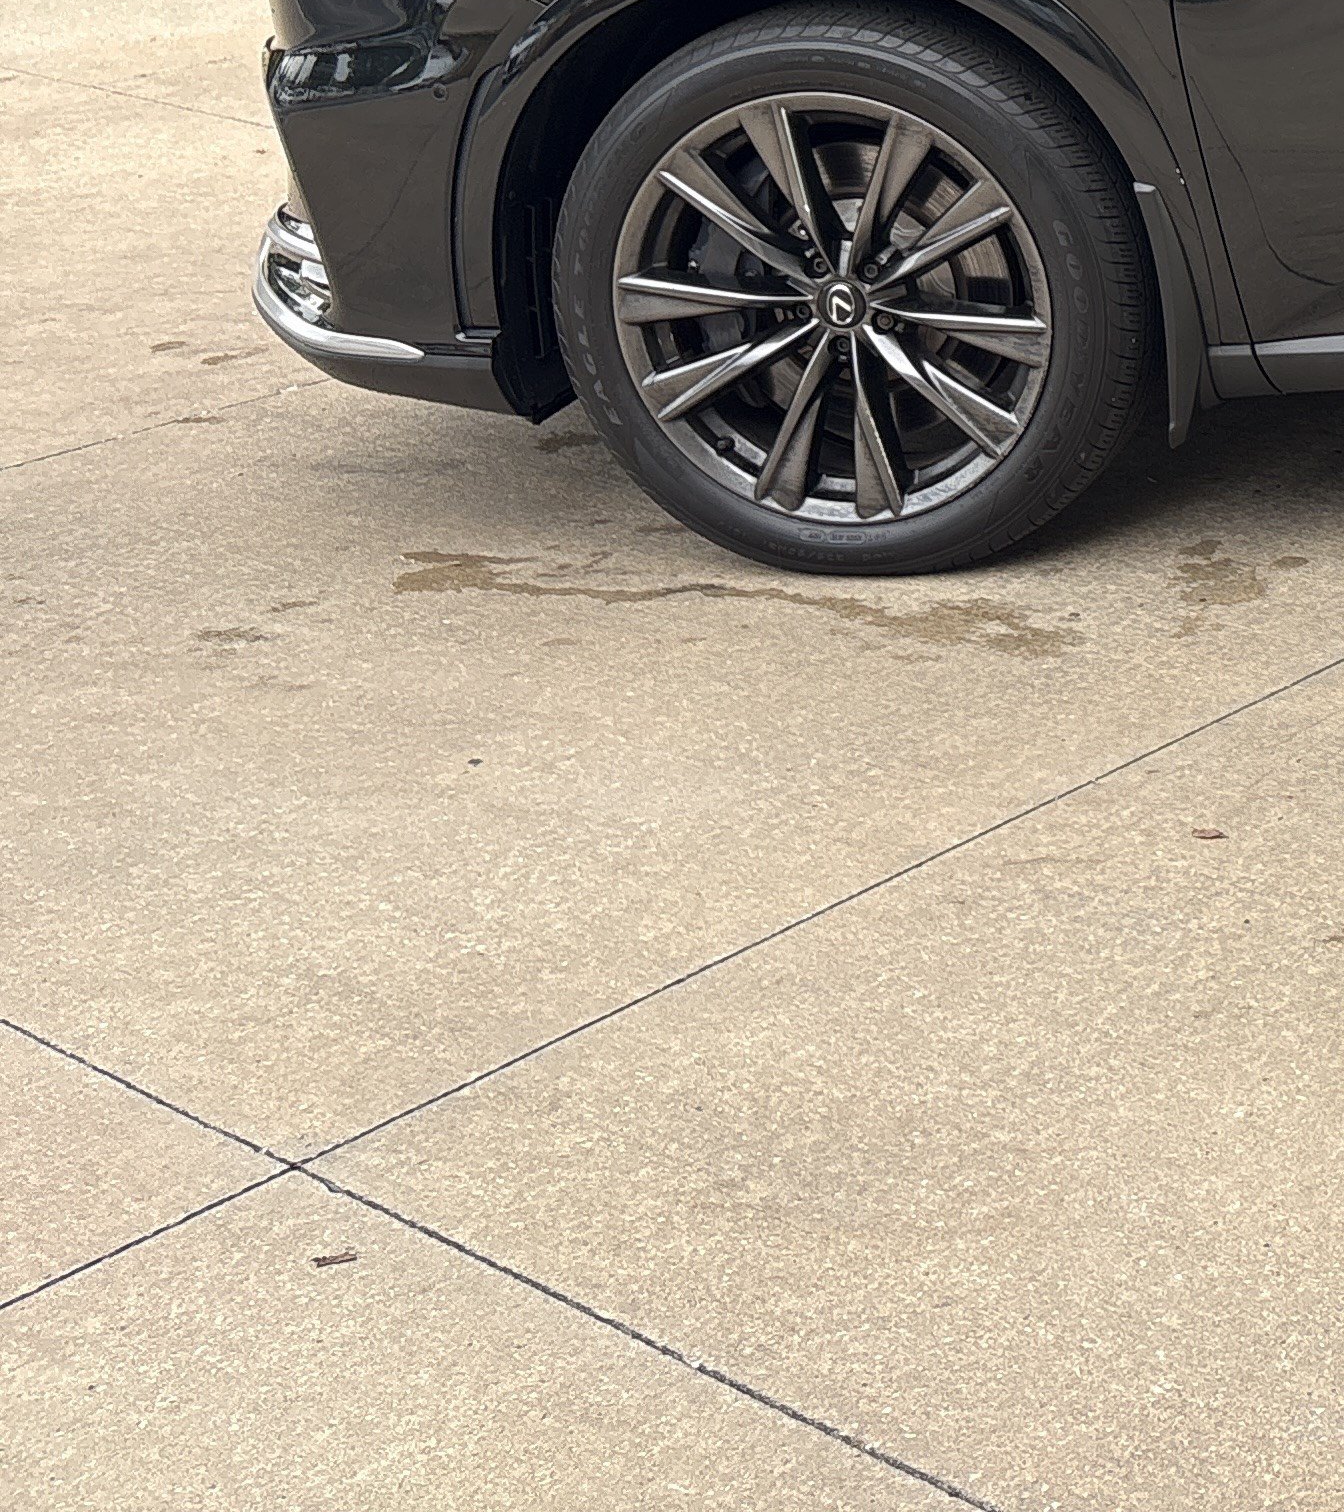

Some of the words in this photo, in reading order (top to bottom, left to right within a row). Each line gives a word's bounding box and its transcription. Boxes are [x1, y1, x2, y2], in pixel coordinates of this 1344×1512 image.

[574, 120, 645, 276] TOUG
[574, 295, 623, 425] EAGLE
[1025, 220, 1090, 483] GOODYEAR
